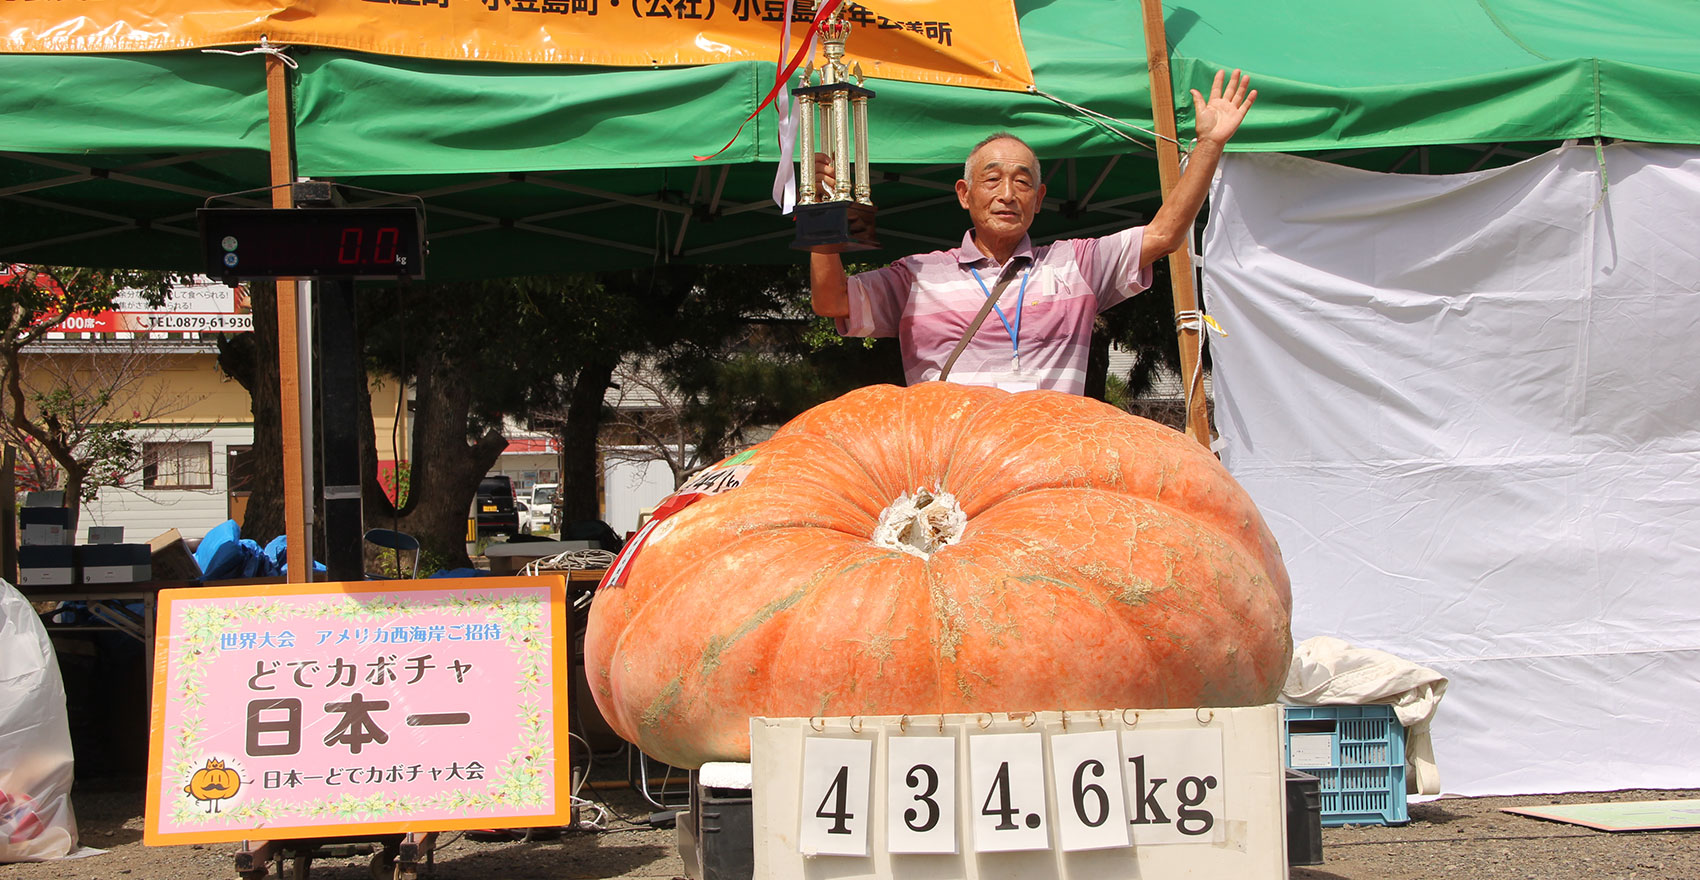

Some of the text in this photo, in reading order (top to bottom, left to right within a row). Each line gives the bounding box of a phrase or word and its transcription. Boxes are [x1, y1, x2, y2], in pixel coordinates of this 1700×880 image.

[338, 228, 407, 265] 0.0 kg
[220, 623, 501, 650] 世界大会 アメリカ西海岸ご招待
[248, 654, 473, 691] どでカボチャ
[246, 693, 471, 757] 日本一
[263, 761, 485, 789] 日本一どでカボチャ大会
